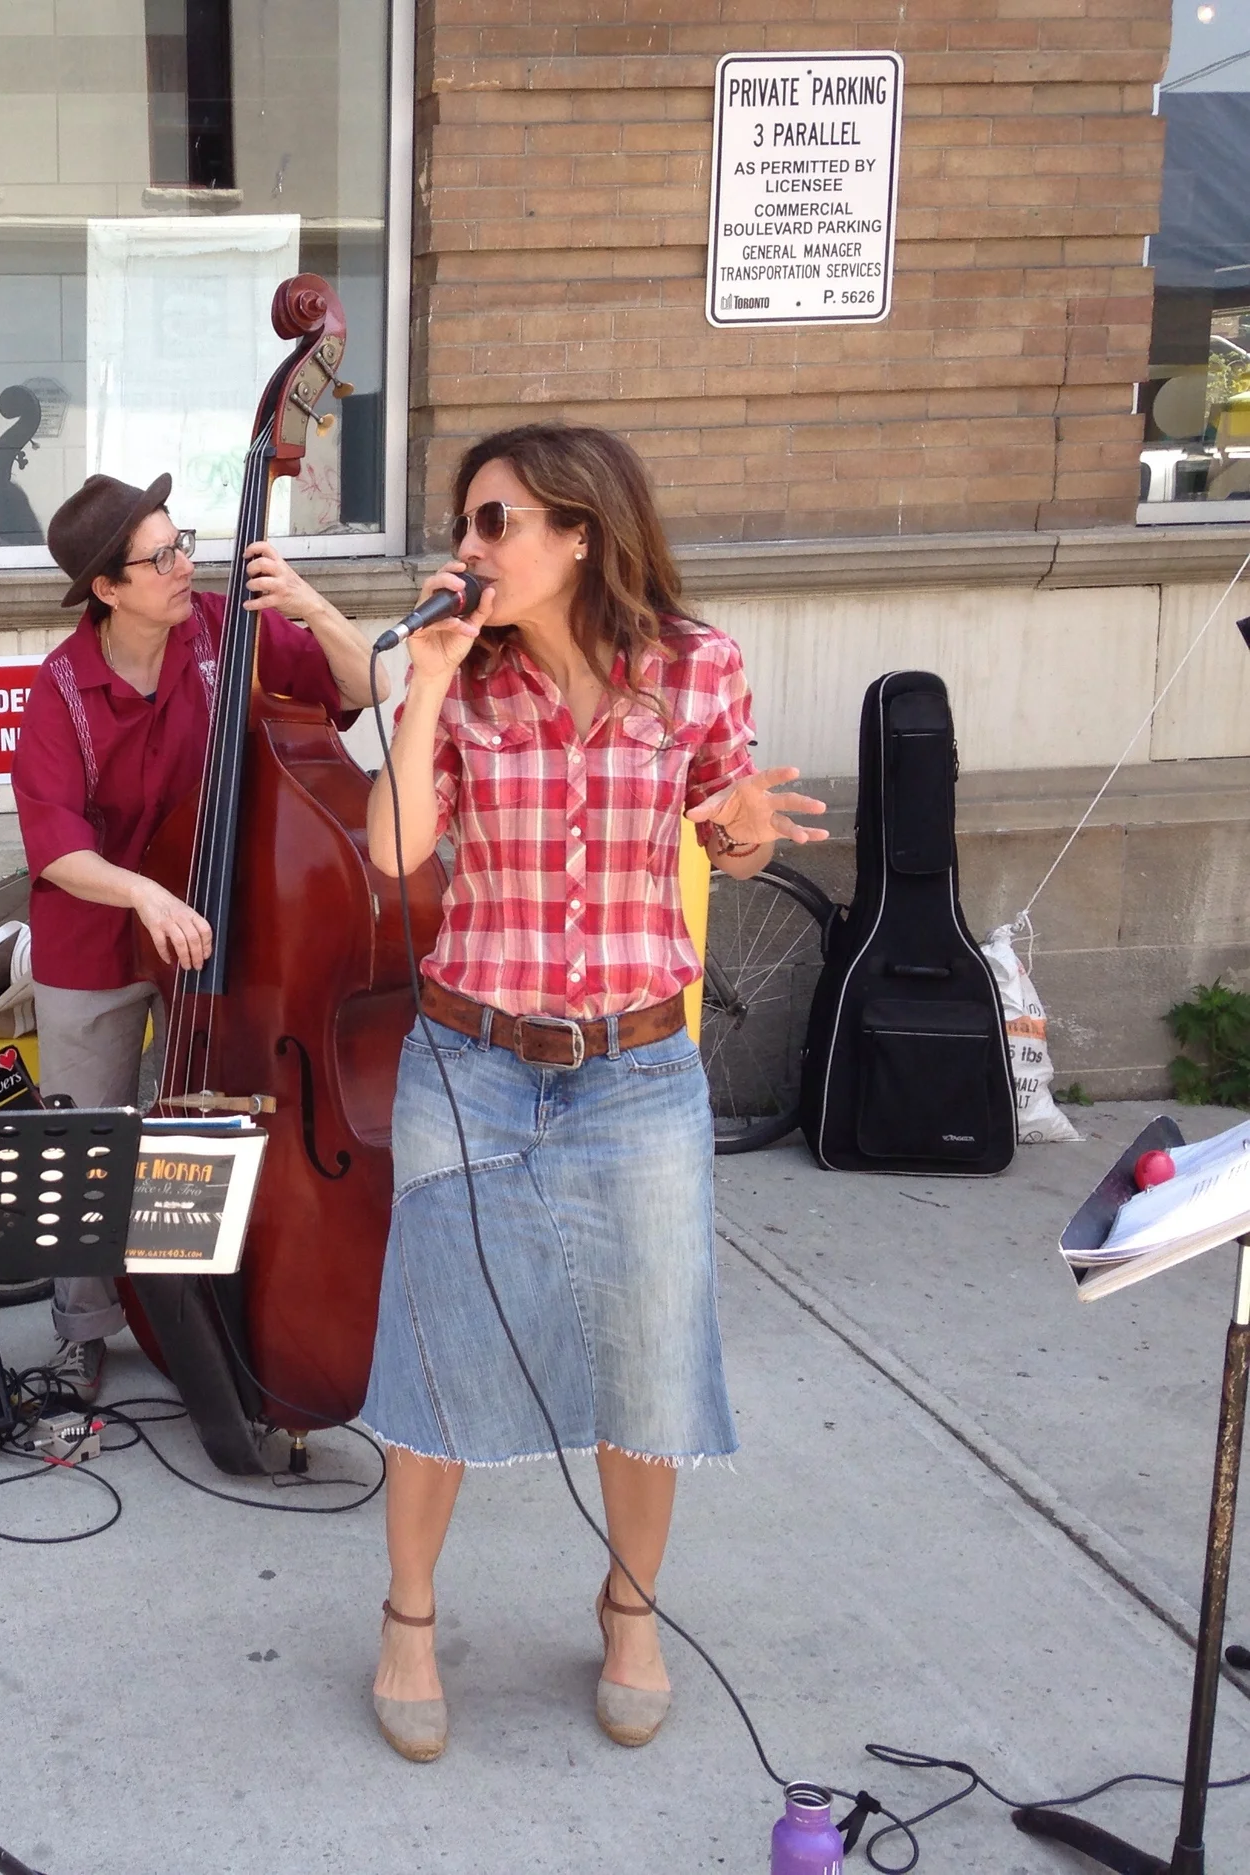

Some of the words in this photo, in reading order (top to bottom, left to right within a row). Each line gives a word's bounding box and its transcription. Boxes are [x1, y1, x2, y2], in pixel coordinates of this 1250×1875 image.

[729, 77, 800, 107] PRIVATE
[811, 75, 887, 106] PARKING
[753, 123, 764, 147] 3
[773, 121, 861, 147] PARALLEL
[734, 161, 756, 176] AS
[760, 159, 850, 174] PERMITTED
[854, 158, 876, 173] BY
[765, 178, 843, 193] LICENSEE
[754, 202, 853, 217] COMMERCIAL
[723, 221, 813, 237] BOULEVARD
[817, 219, 882, 234] PARKING
[742, 244, 797, 260] GENERAL
[803, 242, 862, 258] MANAGER
[720, 263, 820, 281] TRANSPORTATION
[826, 262, 881, 278] SERVICES
[823, 289, 836, 304] P.
[841, 290, 875, 304] 5626
[1021, 1046, 1043, 1063] lbs
[152, 1158, 213, 1183] MORRA
